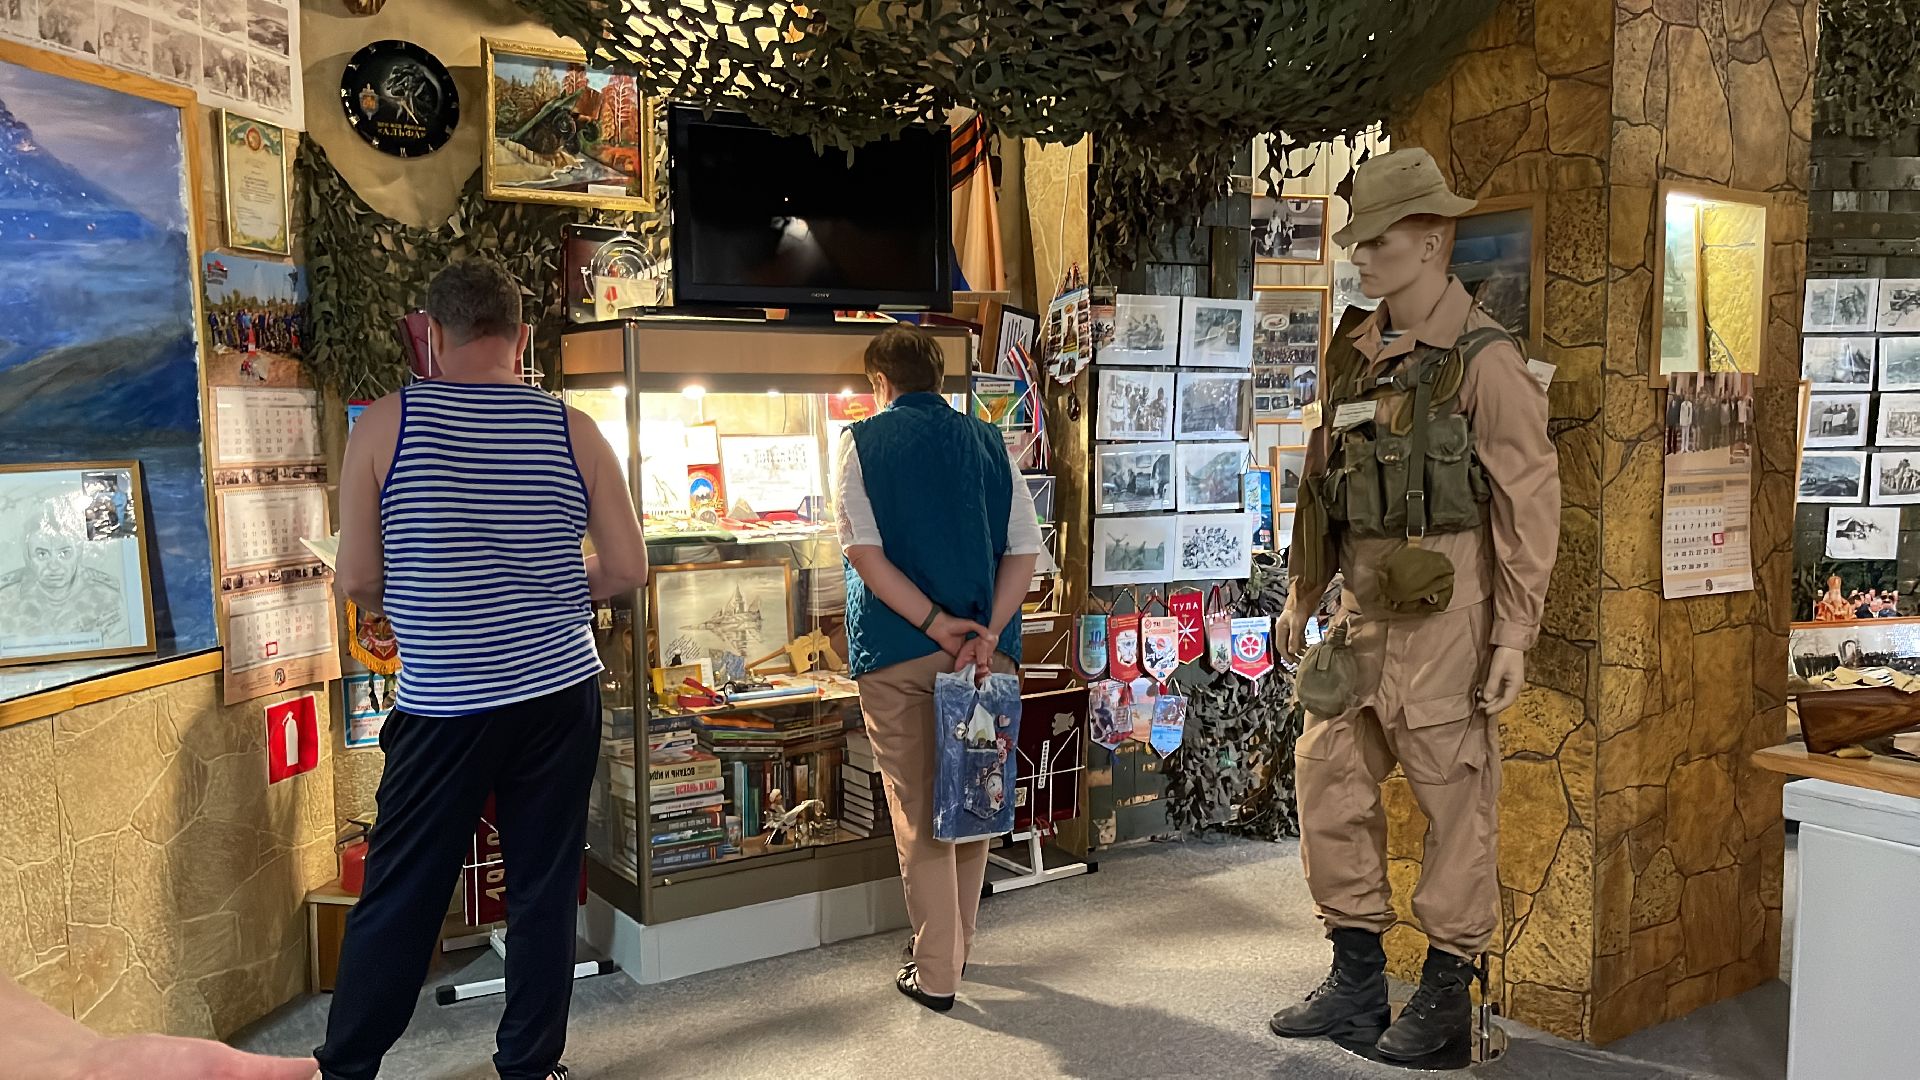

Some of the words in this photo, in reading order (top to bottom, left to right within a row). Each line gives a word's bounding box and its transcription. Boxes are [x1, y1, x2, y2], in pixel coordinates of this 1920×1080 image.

[1172, 602, 1199, 611] ТУЛА
[665, 770, 670, 779] И
[671, 767, 695, 778] ВСТАНЬ
